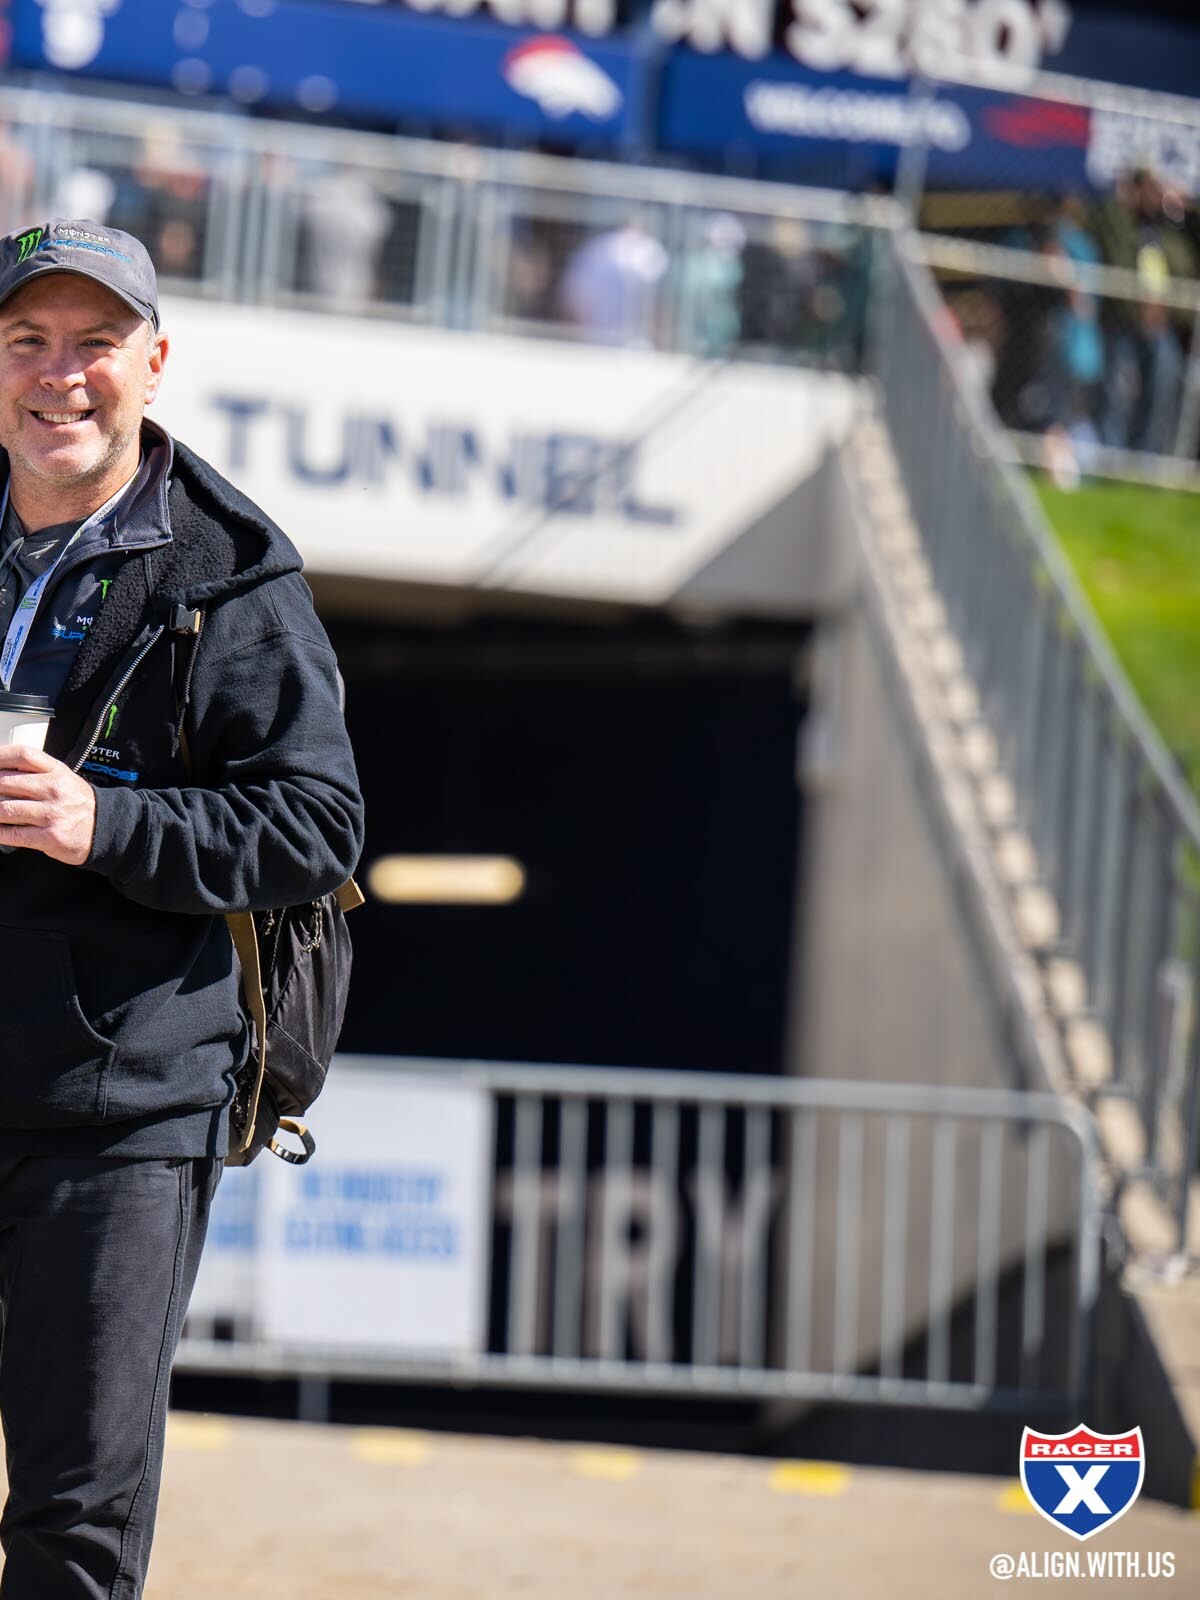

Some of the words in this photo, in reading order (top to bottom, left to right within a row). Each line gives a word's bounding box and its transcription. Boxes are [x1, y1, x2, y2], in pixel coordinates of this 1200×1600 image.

[59, 227, 112, 244] MONSTER
[209, 391, 681, 528] TUNNEL
[90, 746, 120, 760] STER
